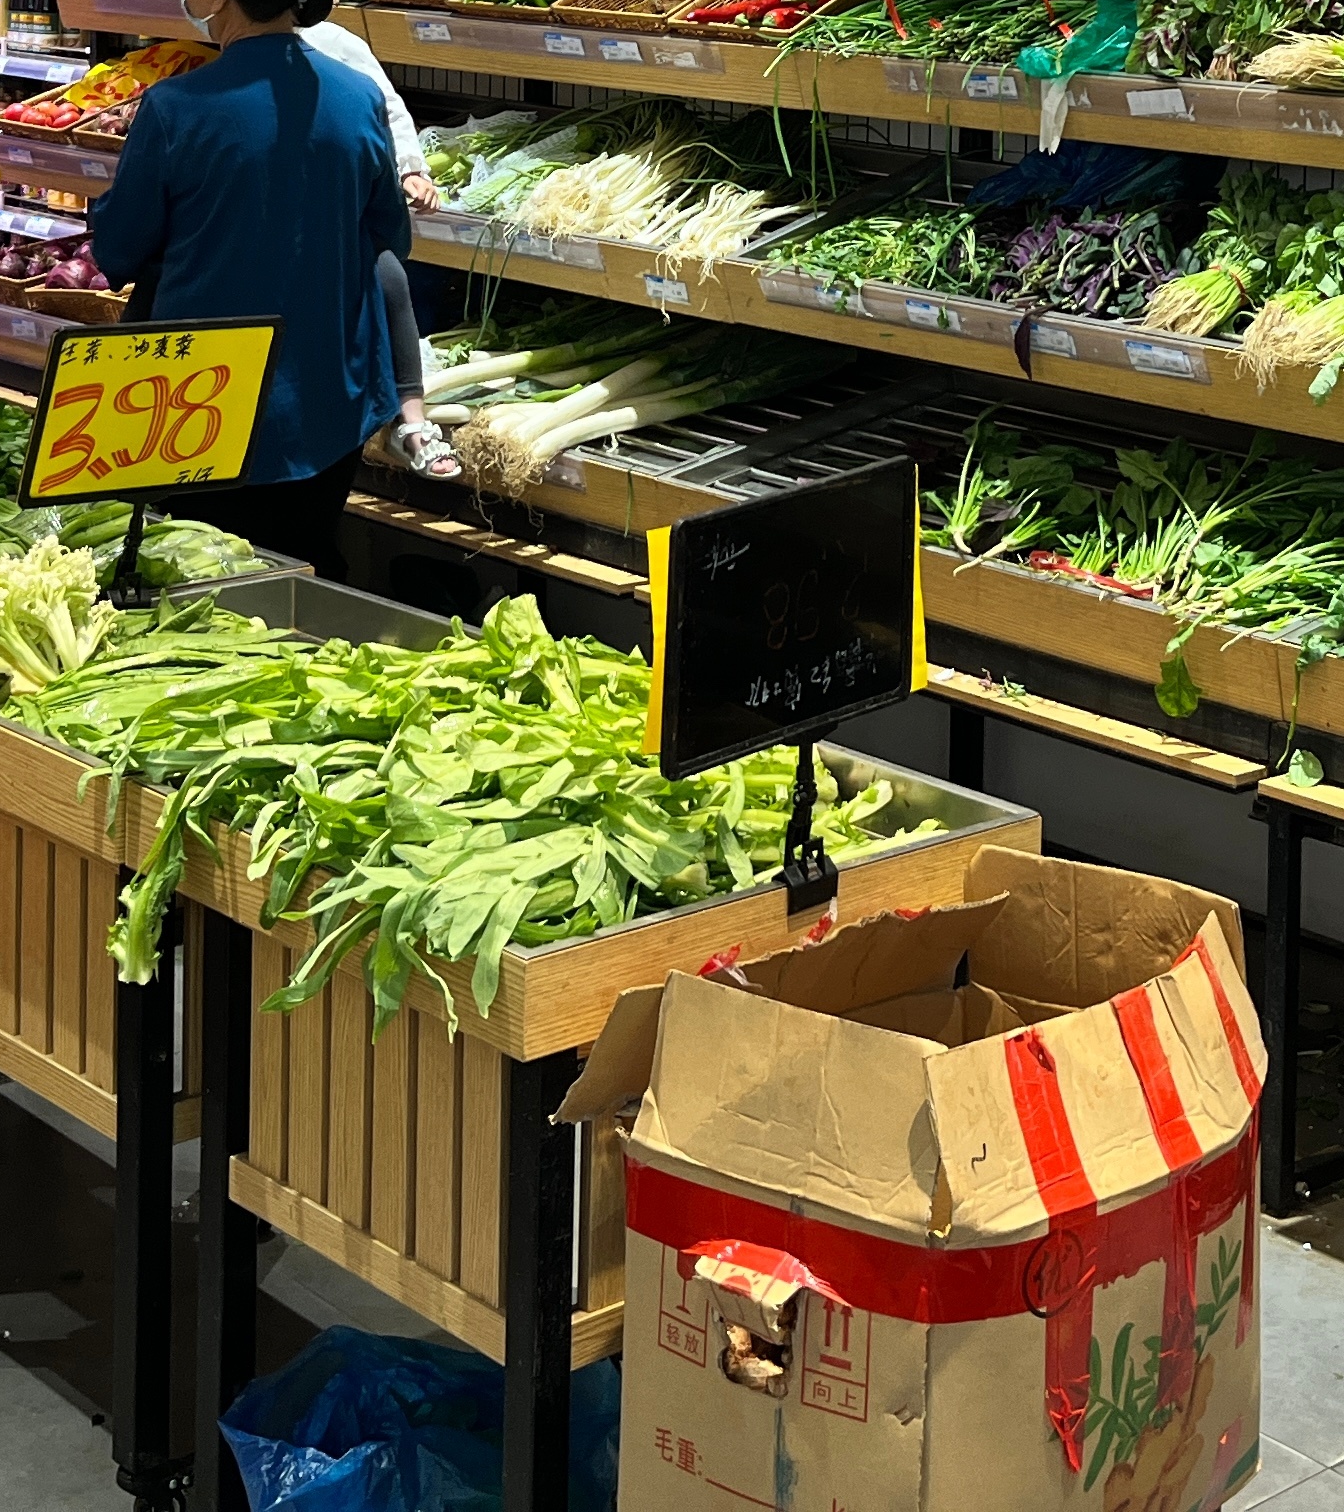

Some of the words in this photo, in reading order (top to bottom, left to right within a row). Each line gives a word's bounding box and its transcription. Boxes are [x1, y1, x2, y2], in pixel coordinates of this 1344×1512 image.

[38, 365, 231, 494] 3.98
[666, 1323, 699, 1356] 轻放
[813, 1380, 858, 1410] 向上
